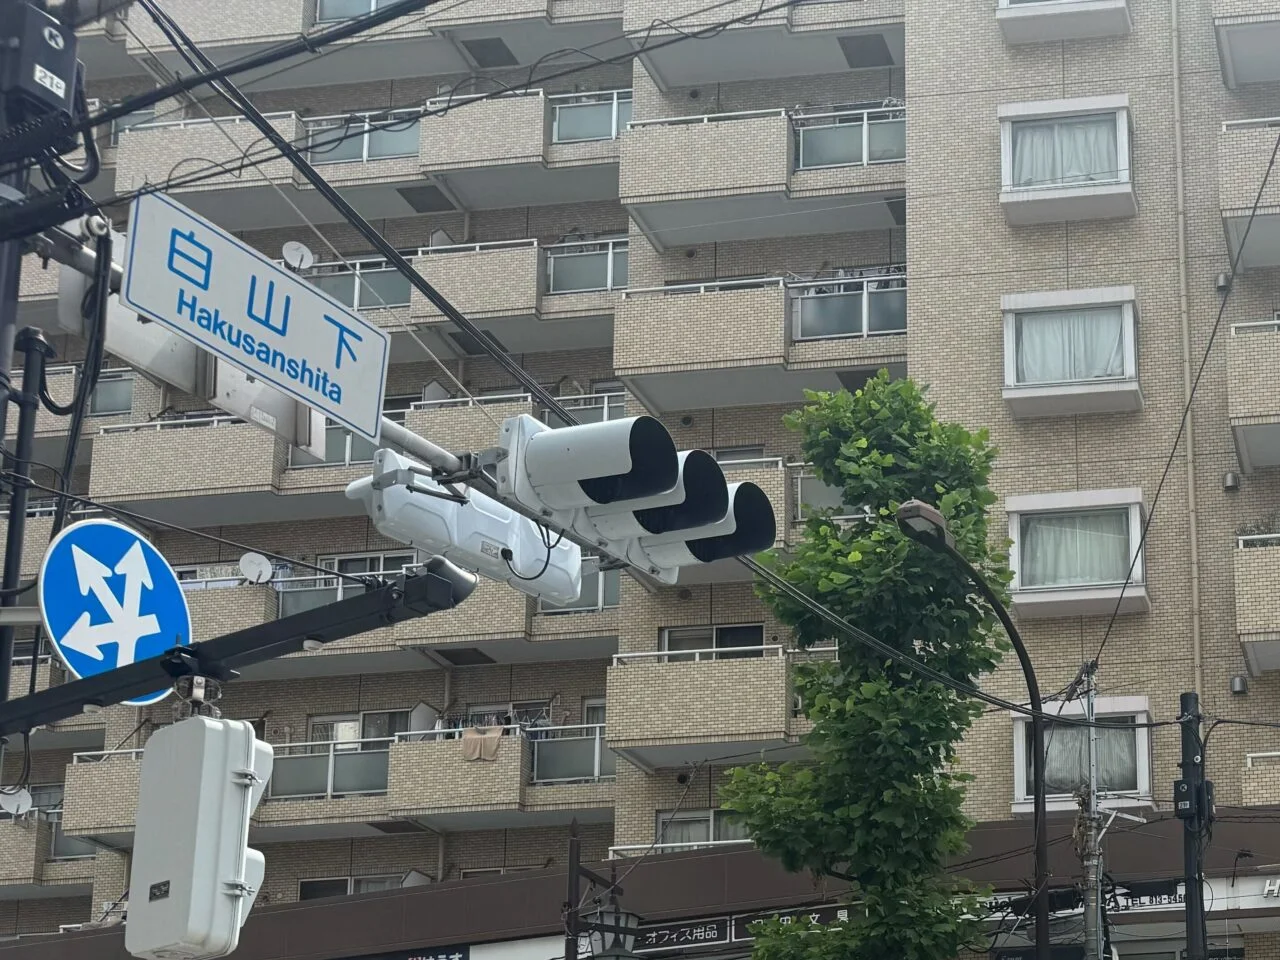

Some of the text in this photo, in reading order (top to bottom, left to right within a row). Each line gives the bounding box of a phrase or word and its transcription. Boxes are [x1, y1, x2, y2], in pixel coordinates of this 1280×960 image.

[168, 227, 363, 370] 白山下
[176, 290, 343, 405] Hakusanshita
[645, 924, 718, 944] オフィス用品
